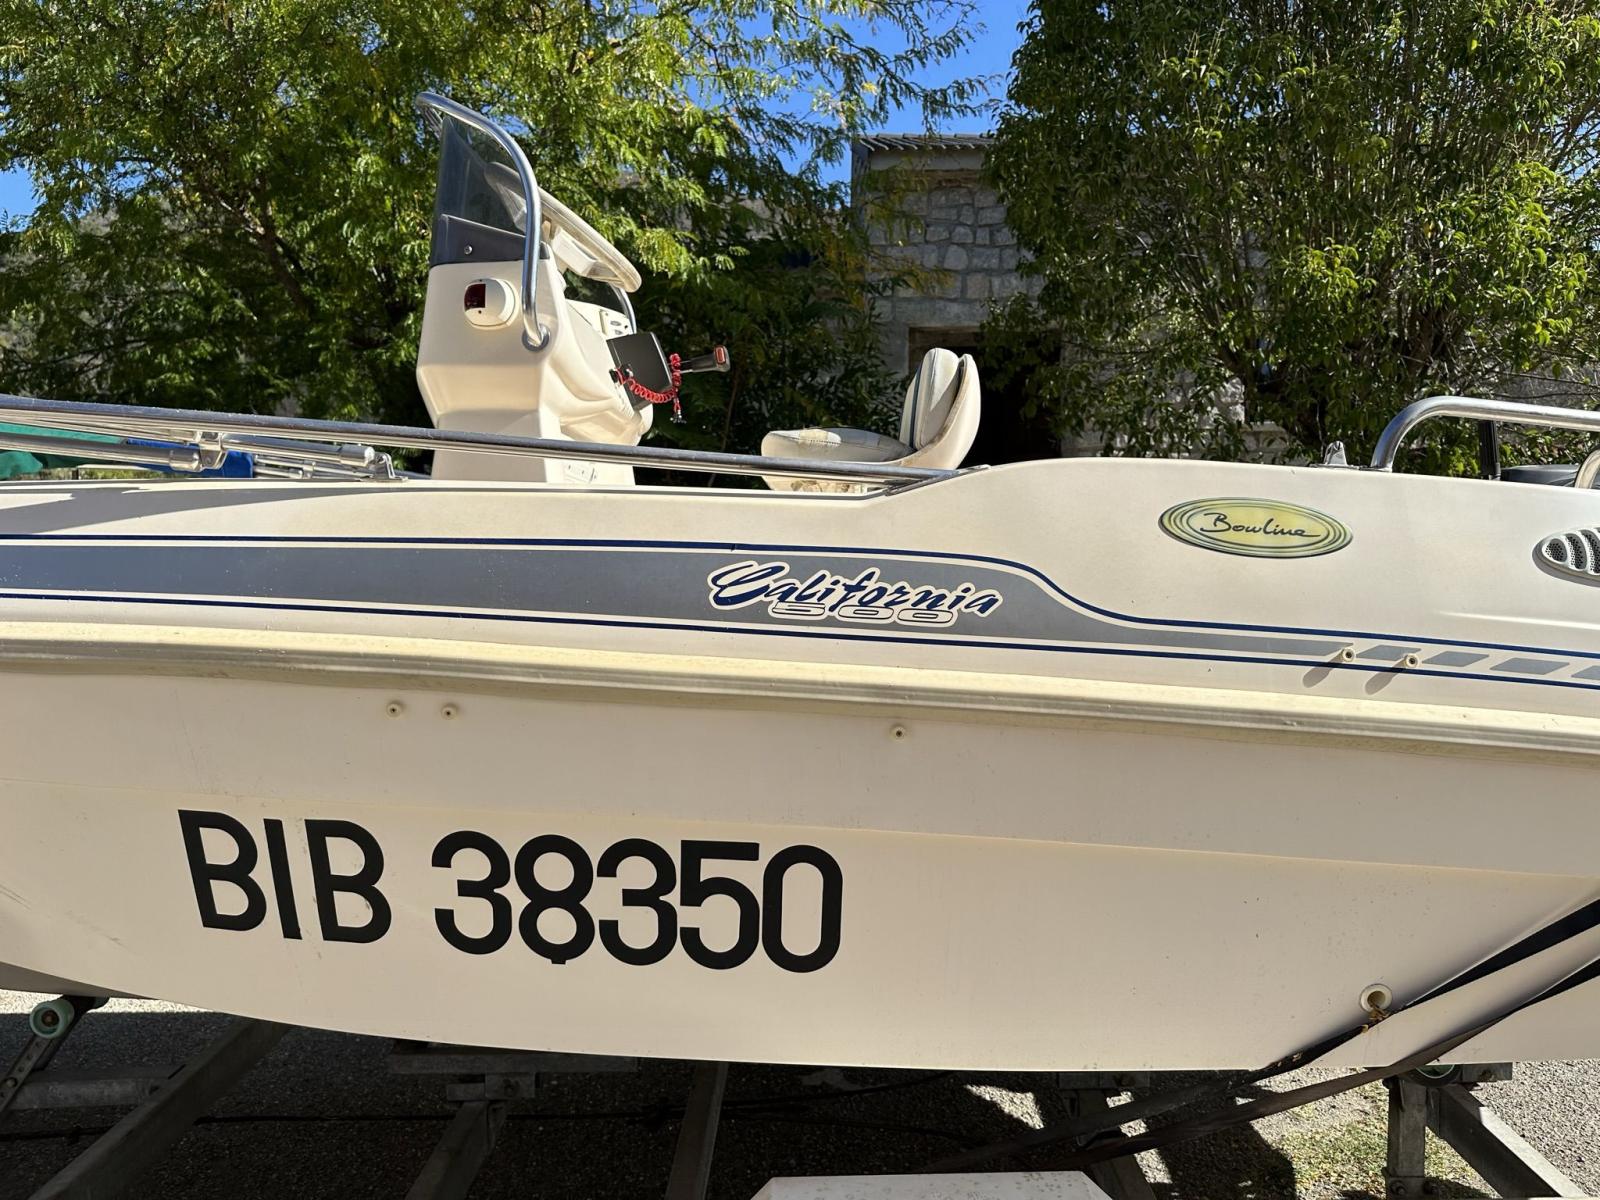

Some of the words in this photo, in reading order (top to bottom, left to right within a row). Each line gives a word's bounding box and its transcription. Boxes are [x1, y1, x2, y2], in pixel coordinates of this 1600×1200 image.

[1199, 512, 1321, 538] Bowline
[709, 562, 1001, 615] California
[771, 600, 954, 623] 500
[178, 809, 392, 944] BIB
[431, 830, 843, 973] 38350
